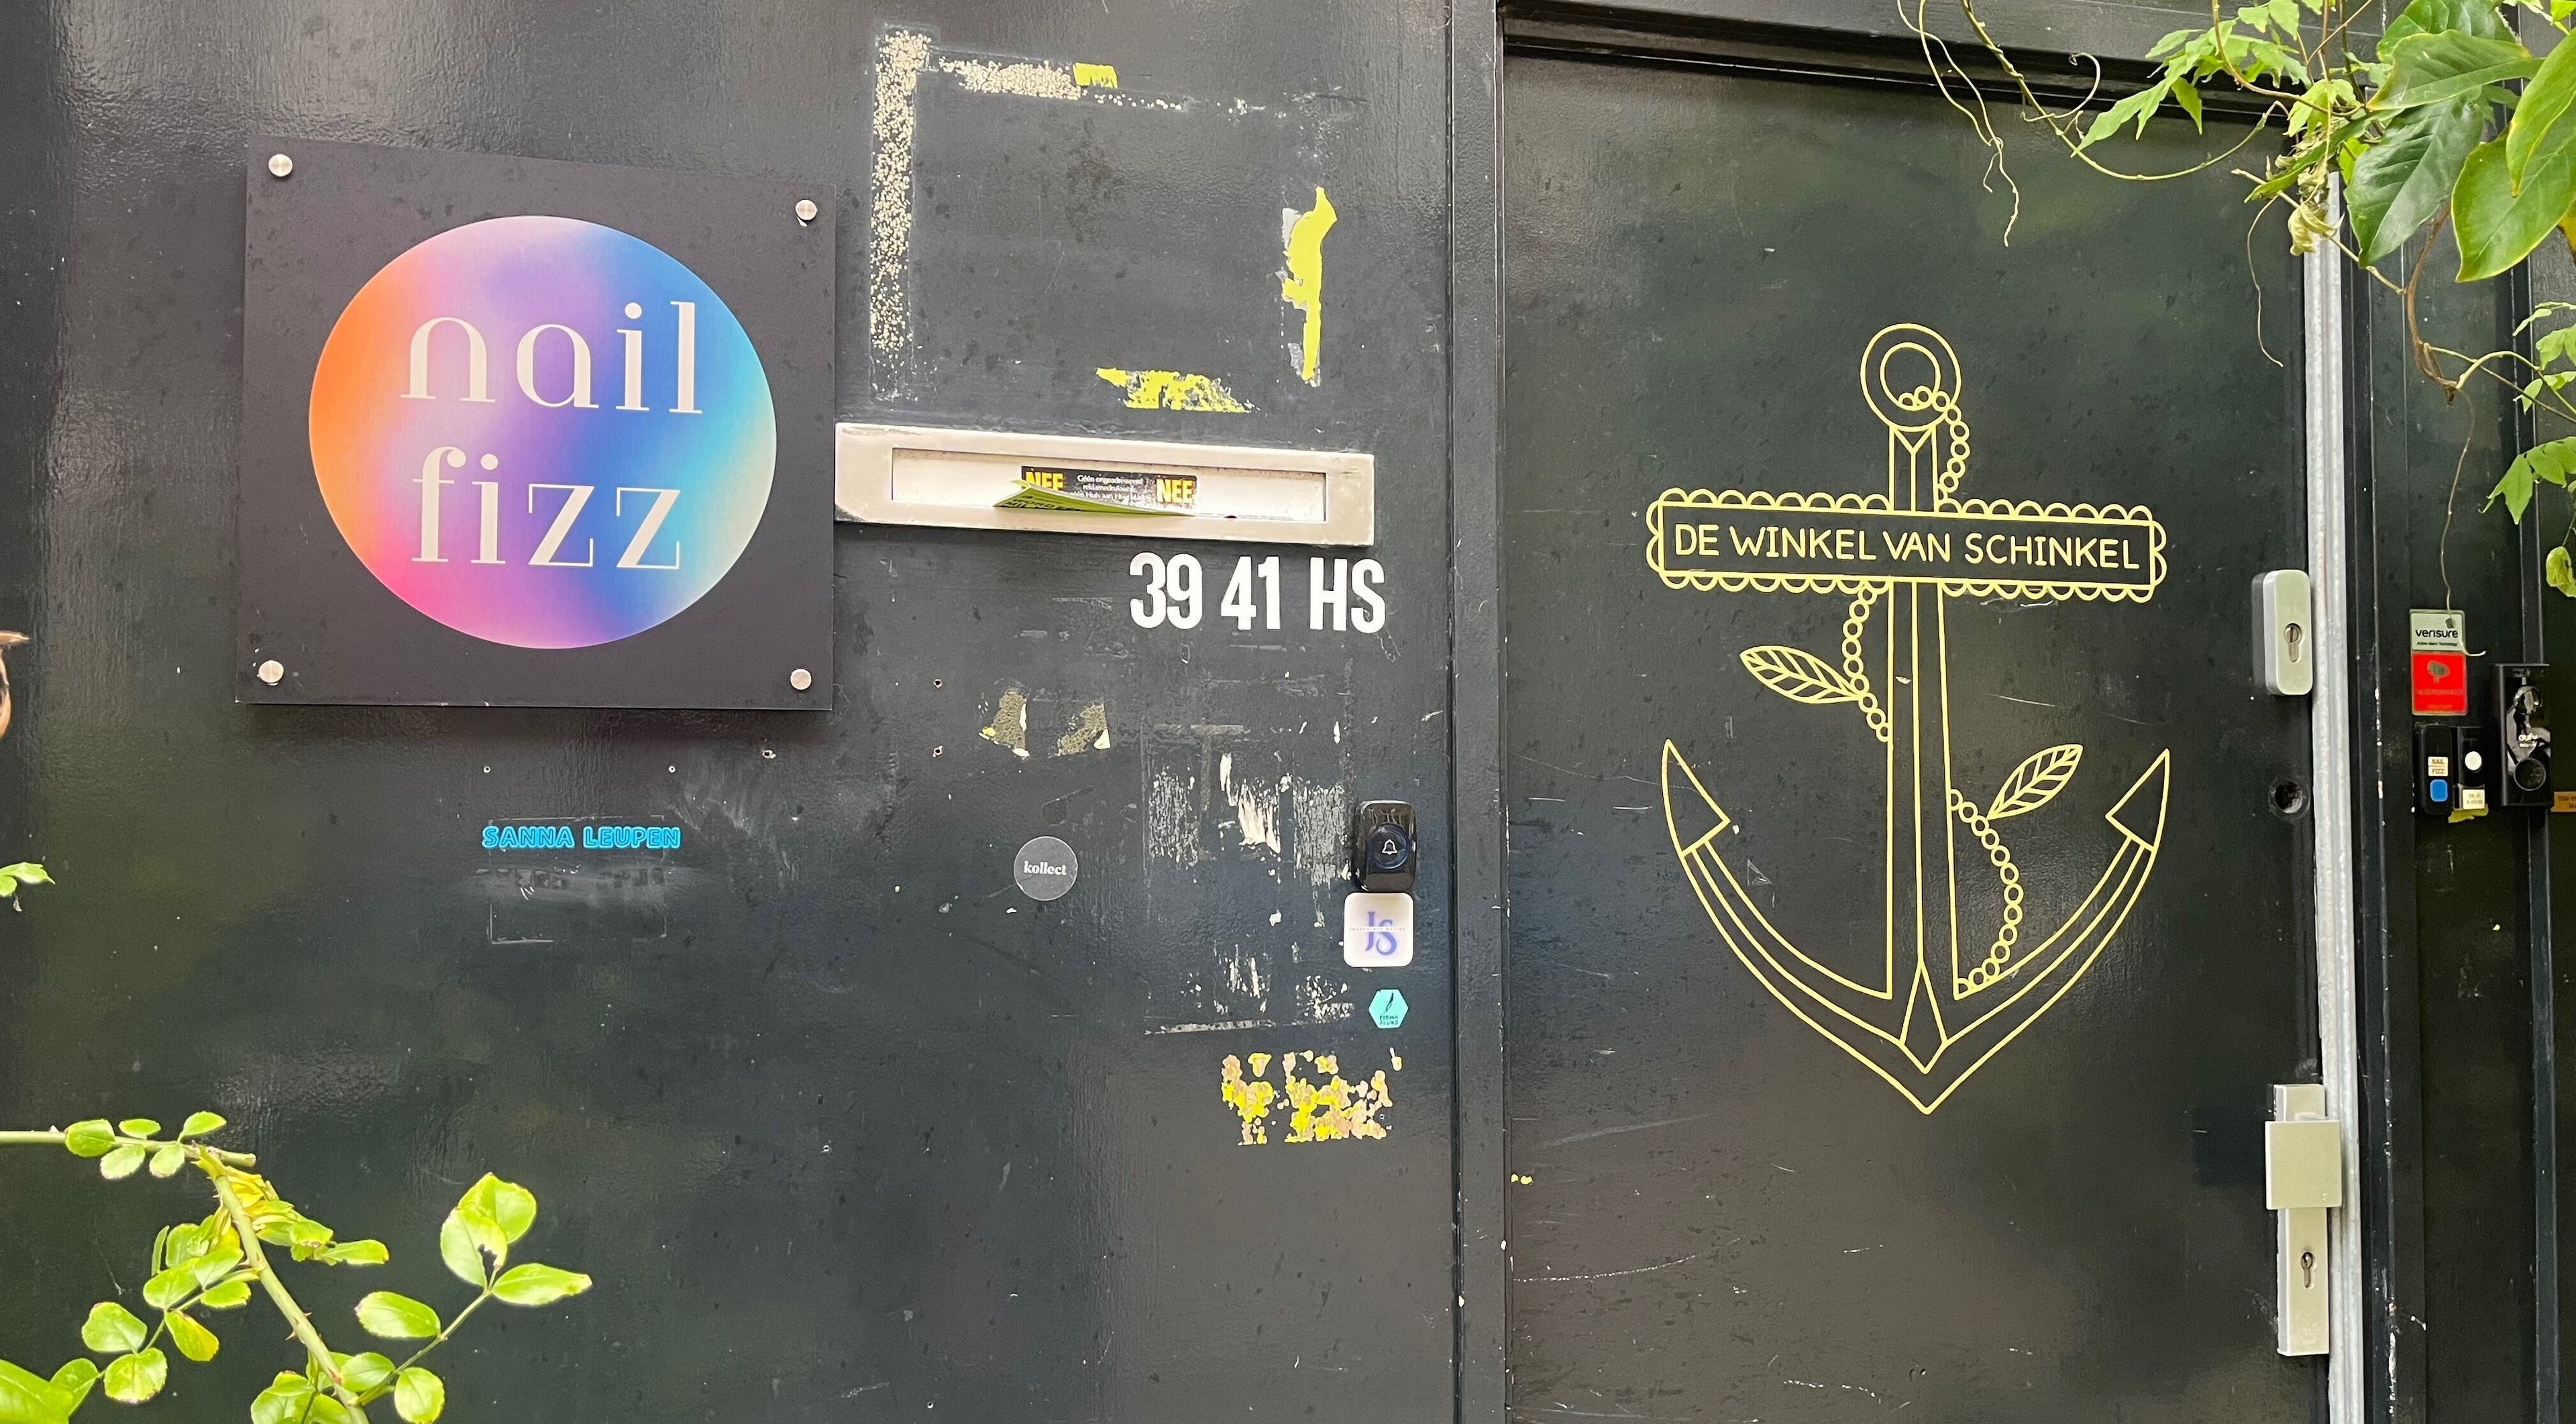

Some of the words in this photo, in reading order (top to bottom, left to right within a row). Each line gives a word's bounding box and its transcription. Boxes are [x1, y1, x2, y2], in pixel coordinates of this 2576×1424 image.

[400, 301, 702, 414] nail
[411, 446, 681, 569] fizz
[1157, 478, 1193, 504] NEE
[1676, 523, 1719, 557] DE
[1729, 525, 1877, 562] WINKEL
[1883, 531, 1951, 563] VAN
[1964, 534, 2140, 571] SCHINKEL
[1129, 551, 1203, 629] 39
[1221, 556, 1281, 630] 41
[1309, 557, 1386, 633] HS
[2415, 629, 2458, 639] verisure
[481, 826, 575, 848] SANNA
[583, 826, 681, 849] LEUPEN
[1024, 860, 1067, 876] kollect
